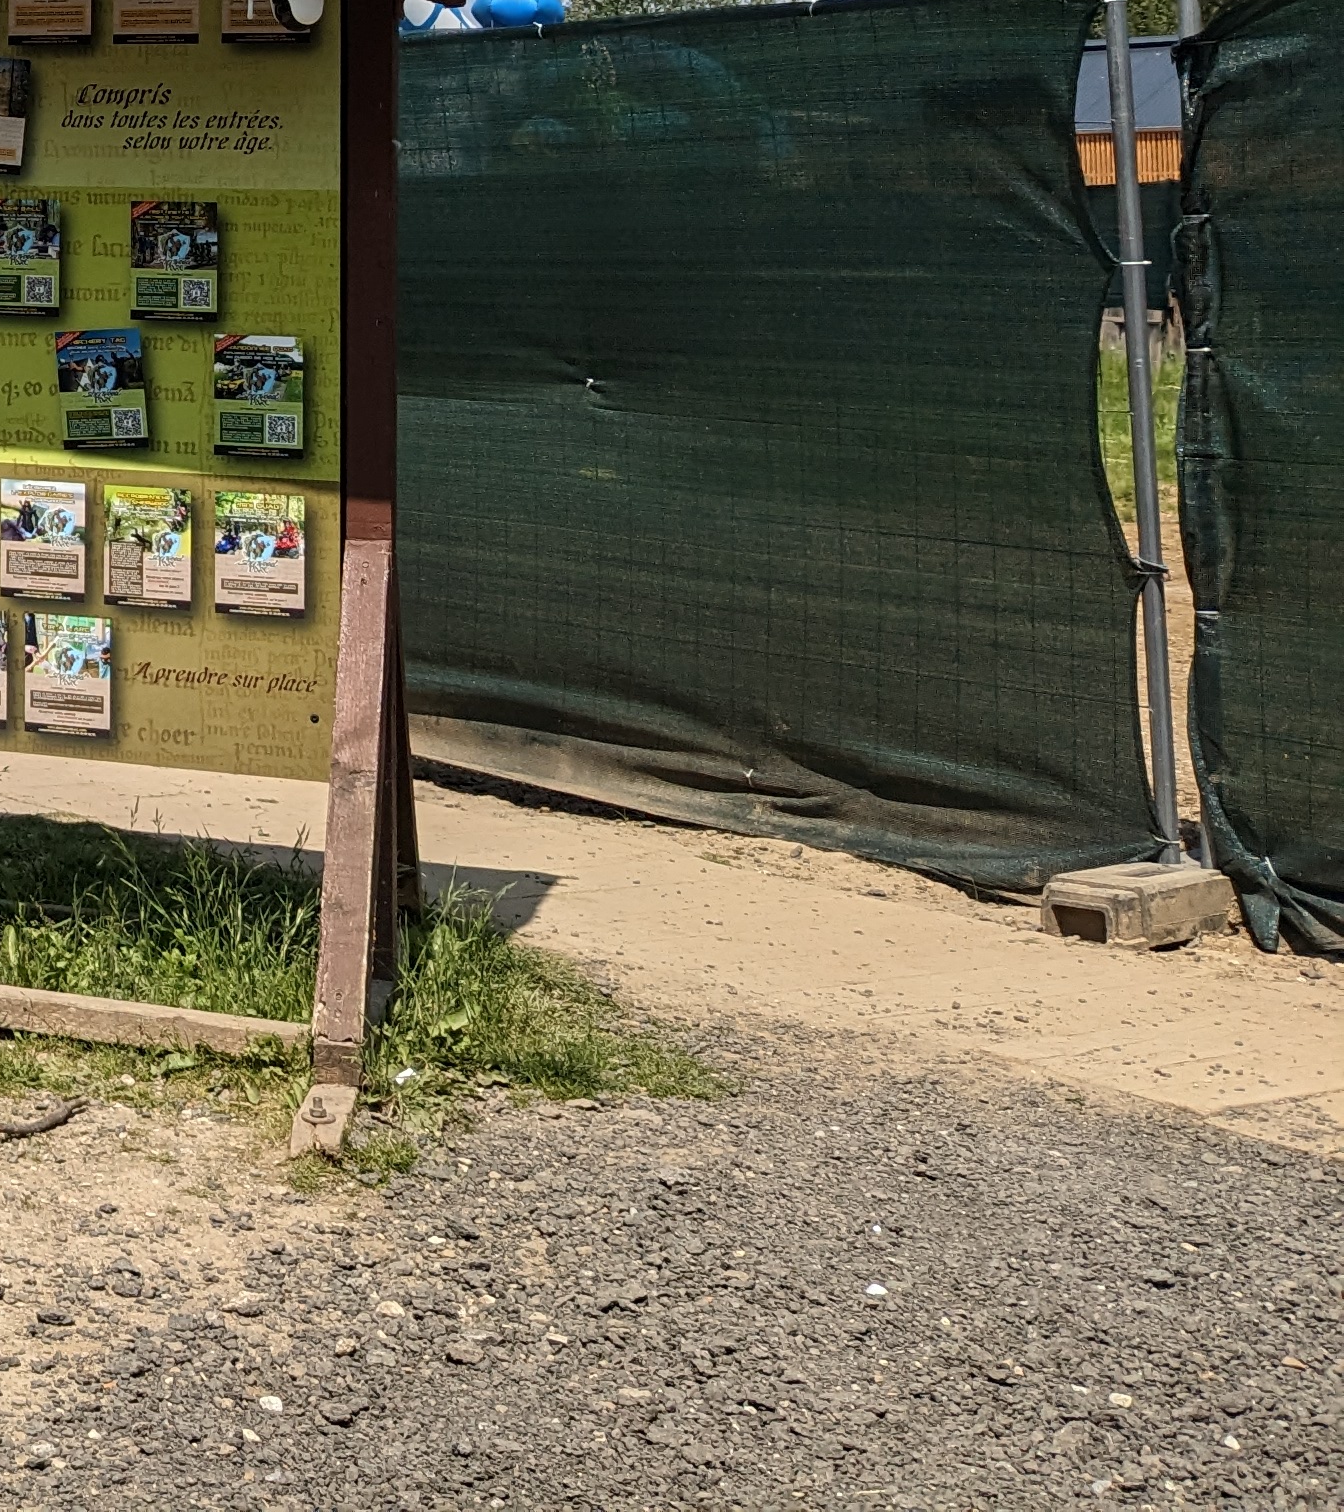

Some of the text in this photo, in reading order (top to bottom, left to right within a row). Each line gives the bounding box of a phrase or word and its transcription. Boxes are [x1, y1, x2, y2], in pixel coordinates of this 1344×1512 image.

[77, 82, 172, 109] Compris
[61, 109, 104, 129] dans
[109, 110, 168, 130] toutes
[172, 109, 200, 129] les
[123, 131, 172, 151] selon
[179, 133, 229, 151] votre
[154, 666, 228, 685] prendre
[232, 673, 264, 688] sur
[266, 672, 318, 694] place
